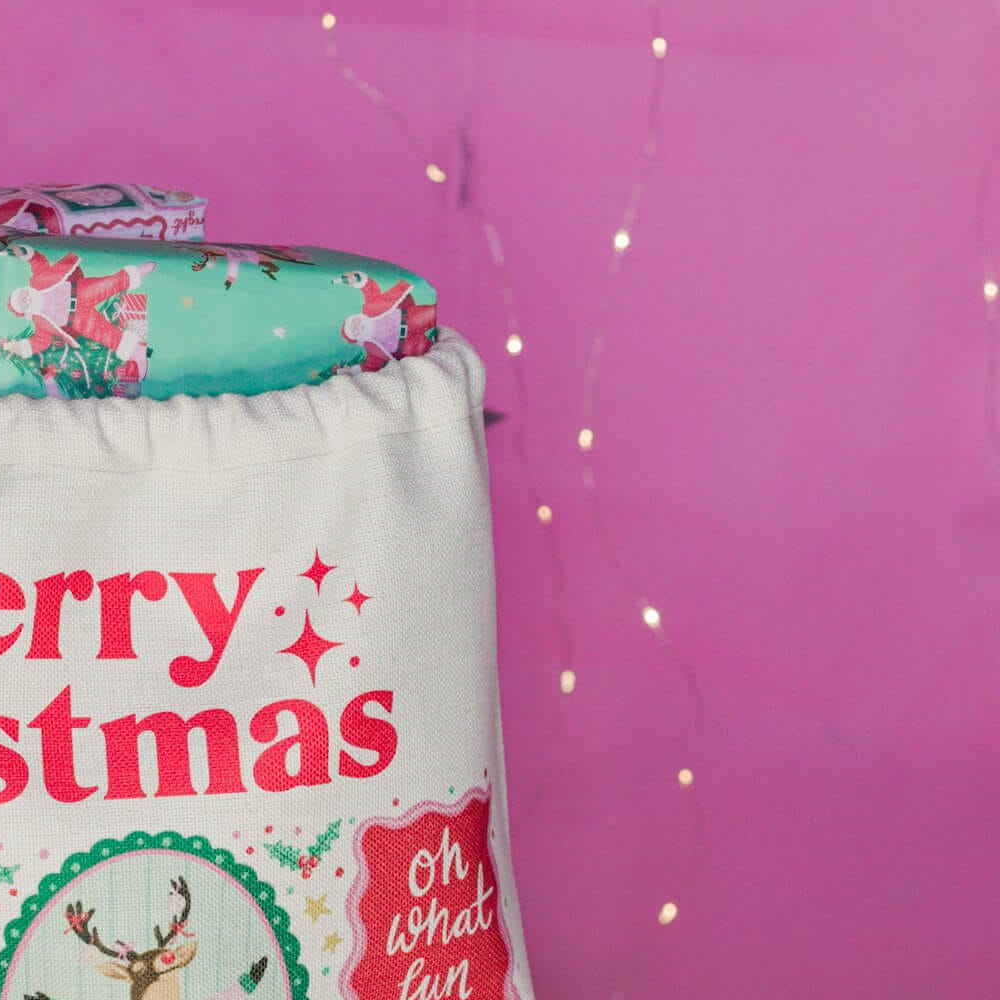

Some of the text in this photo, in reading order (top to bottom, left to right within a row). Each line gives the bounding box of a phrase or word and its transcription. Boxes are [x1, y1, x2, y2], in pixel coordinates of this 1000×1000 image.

[171, 211, 205, 235] right
[408, 826, 469, 897] oh
[386, 863, 494, 956] what
